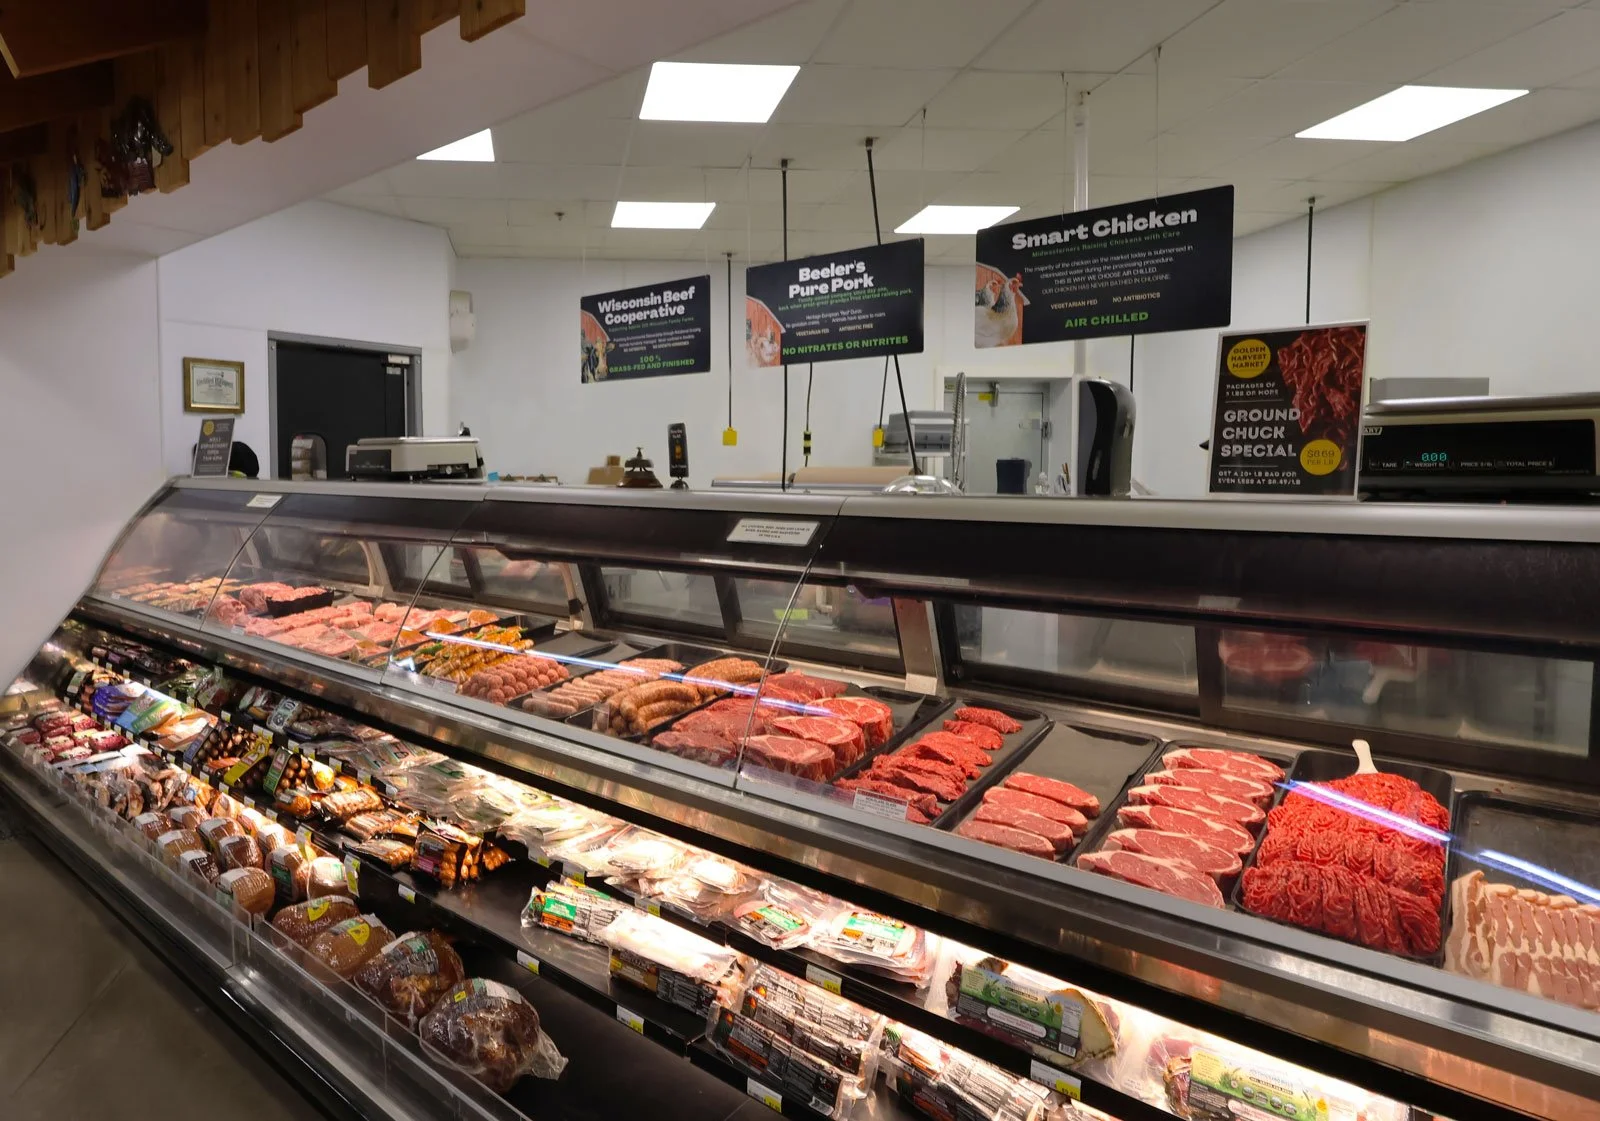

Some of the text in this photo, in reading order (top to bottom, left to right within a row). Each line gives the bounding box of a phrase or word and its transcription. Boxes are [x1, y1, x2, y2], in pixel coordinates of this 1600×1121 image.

[1011, 208, 1198, 250] Smart Chicken
[1032, 230, 1181, 258] Midwesterners Raising Chickens with Care
[1034, 263, 1054, 273] majority
[1070, 259, 1091, 267] chicken
[1109, 253, 1130, 261] market
[1131, 251, 1146, 260] today
[1069, 268, 1084, 276] water
[1085, 266, 1102, 275] during
[1102, 264, 1112, 272] the
[1112, 260, 1142, 270] processing
[798, 259, 867, 282] Beeler's
[1072, 275, 1087, 283] WHY
[1098, 271, 1121, 280] CHOOSE
[788, 273, 875, 299] Pure Pork
[597, 285, 696, 314] Wisconsin Beef
[1050, 291, 1161, 310] VEGETARIAN FED NO ANTIBIOTICS
[604, 304, 685, 326] Cooperative
[1064, 311, 1149, 328] AIR CHILLED
[862, 322, 874, 330] FREE
[782, 335, 909, 356] NO NITRATES OR NITRITES
[1232, 346, 1266, 354] GOLDEN
[639, 355, 654, 364] 100
[1231, 353, 1267, 362] HARVEST
[1232, 361, 1265, 369] MARKET
[609, 358, 695, 374] GRASS-FED AND FINISHED
[1226, 382, 1265, 390] PACKAGES
[1223, 408, 1301, 423] GROUND
[1222, 426, 1285, 440] CHUCK
[1220, 443, 1297, 458] SPECIAL
[1307, 458, 1334, 466] PER LB
